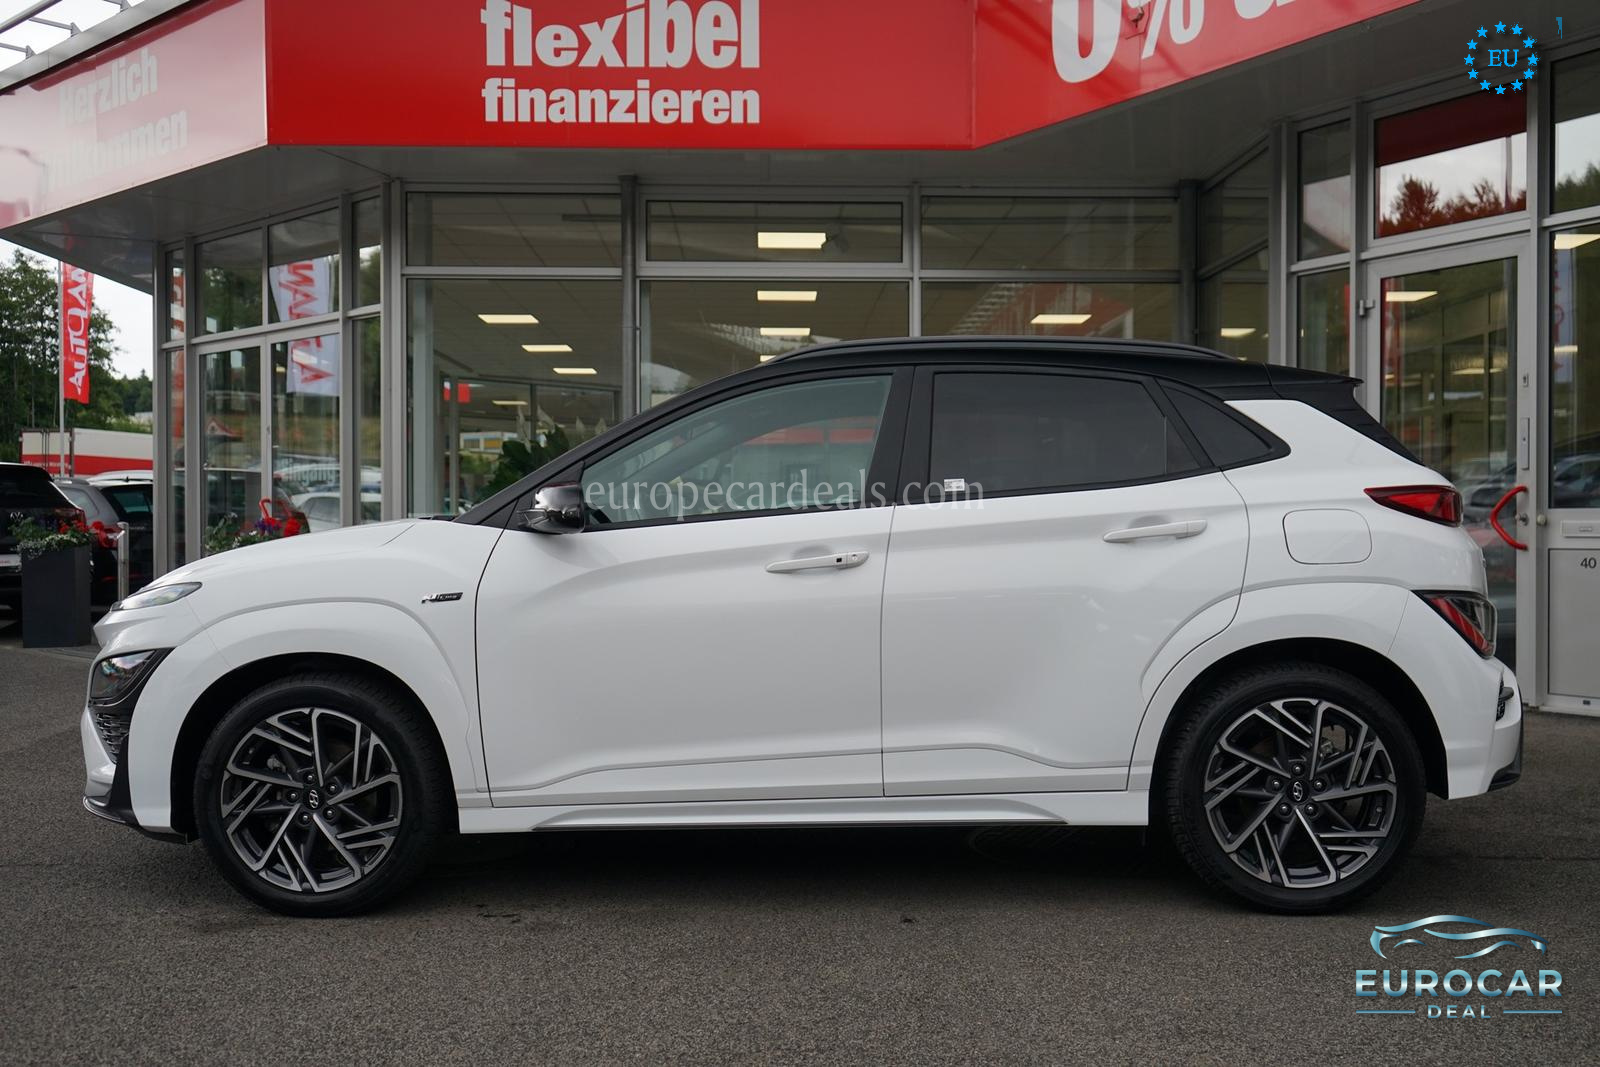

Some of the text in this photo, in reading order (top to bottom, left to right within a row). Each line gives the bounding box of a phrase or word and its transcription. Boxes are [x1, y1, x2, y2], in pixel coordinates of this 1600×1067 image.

[480, 0, 761, 69] flexibel
[481, 77, 760, 124] finanzieren
[1580, 557, 1597, 569] 40
